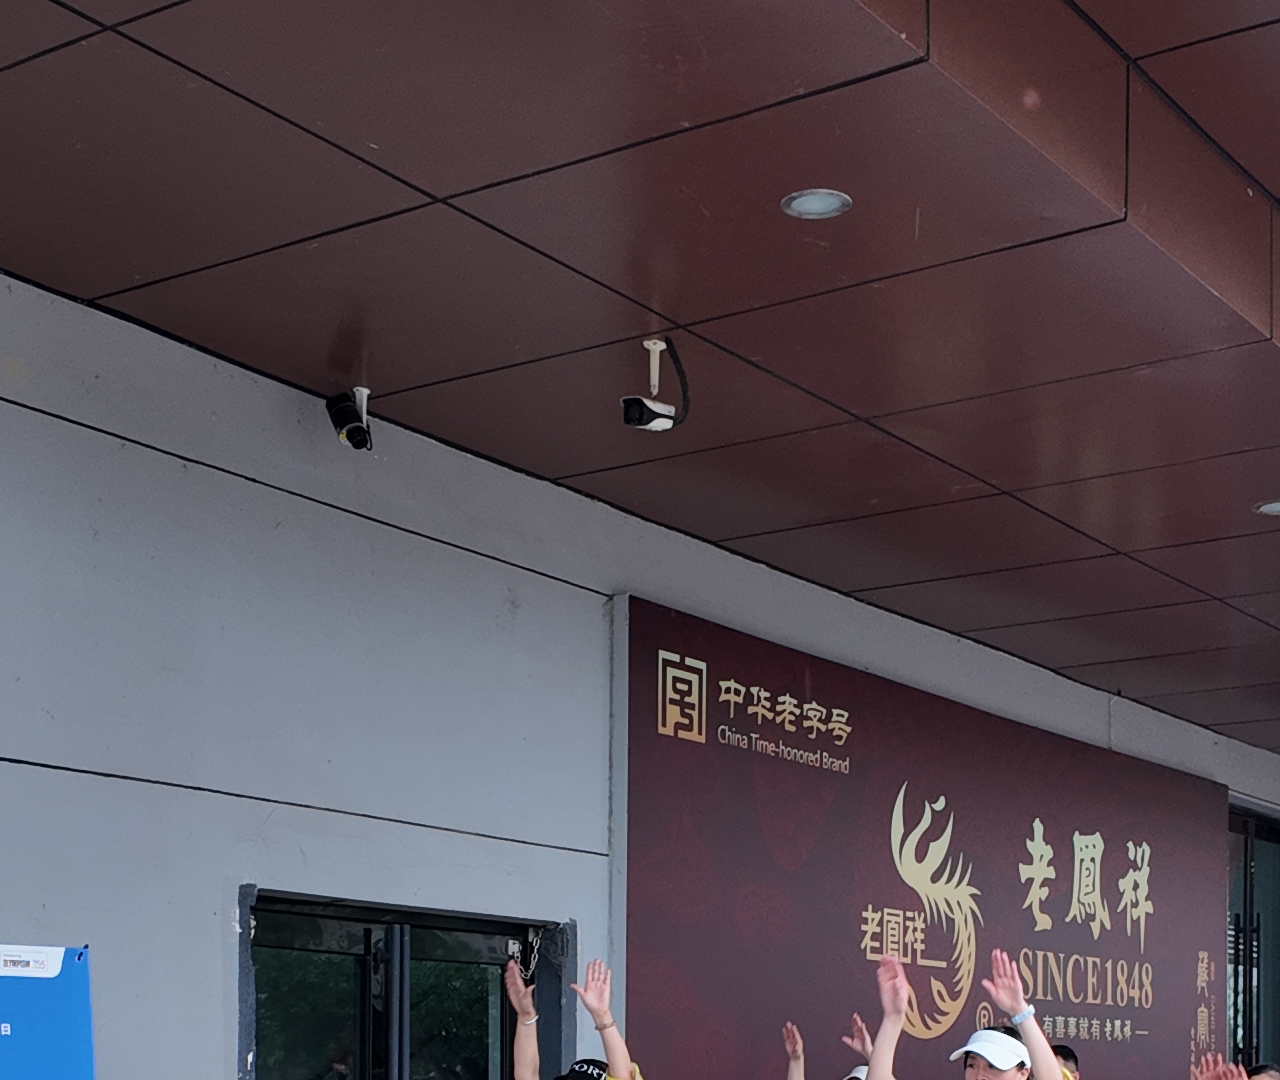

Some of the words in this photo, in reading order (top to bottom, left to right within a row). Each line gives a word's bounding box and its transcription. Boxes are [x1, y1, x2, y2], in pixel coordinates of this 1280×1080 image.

[718, 678, 852, 746] 中华老字号
[717, 725, 748, 749] China
[750, 733, 820, 767] Time-honored
[822, 752, 850, 774] Brand
[1018, 817, 1154, 954] 老鳳祥
